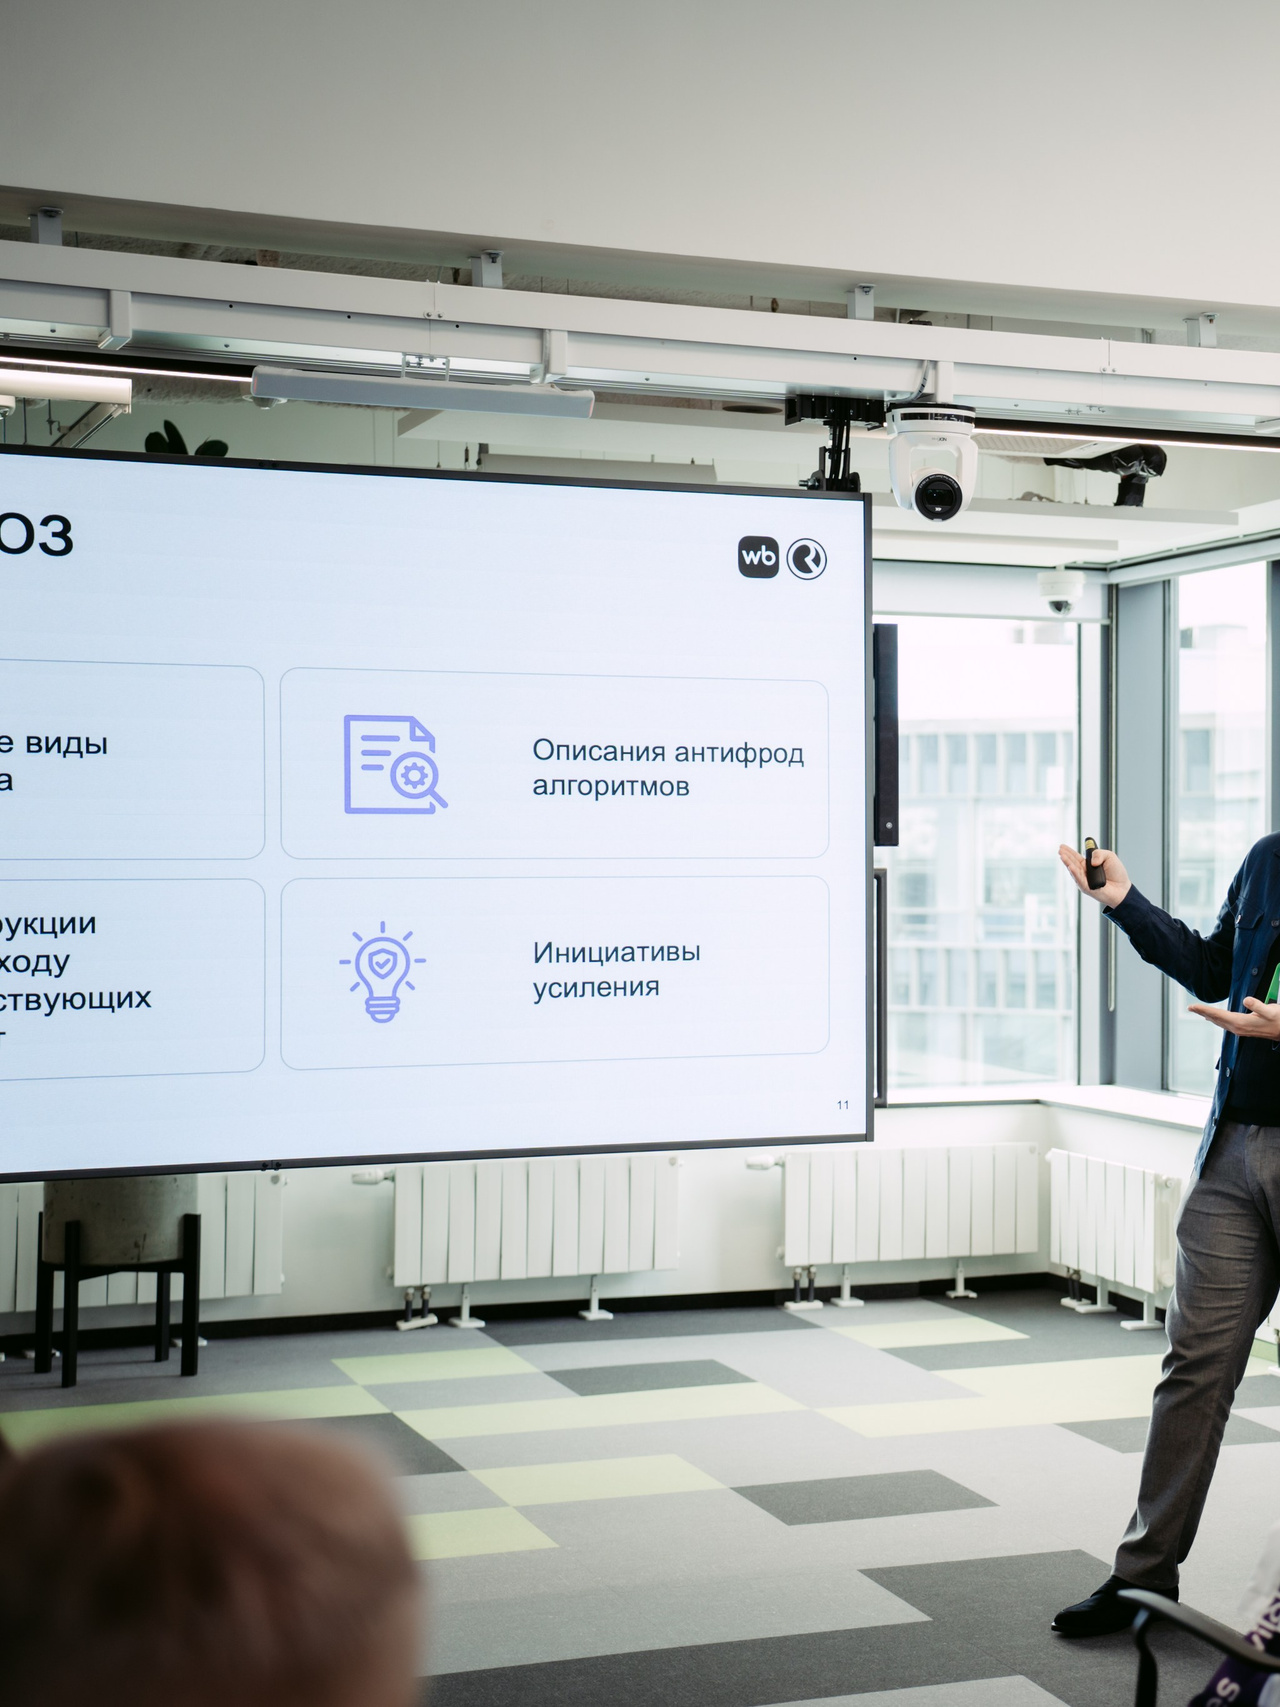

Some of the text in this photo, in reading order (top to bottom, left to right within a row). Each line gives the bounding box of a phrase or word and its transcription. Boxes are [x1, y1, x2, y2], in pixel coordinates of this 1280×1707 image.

[742, 545, 776, 566] wb
[26, 735, 108, 759] виды
[532, 737, 805, 769] Описания антифрод
[532, 778, 690, 802] алгоритмов
[0, 915, 96, 942] укции
[534, 941, 700, 967] Инициативы
[532, 979, 660, 1005] усиления
[837, 1100, 849, 1110] 11
